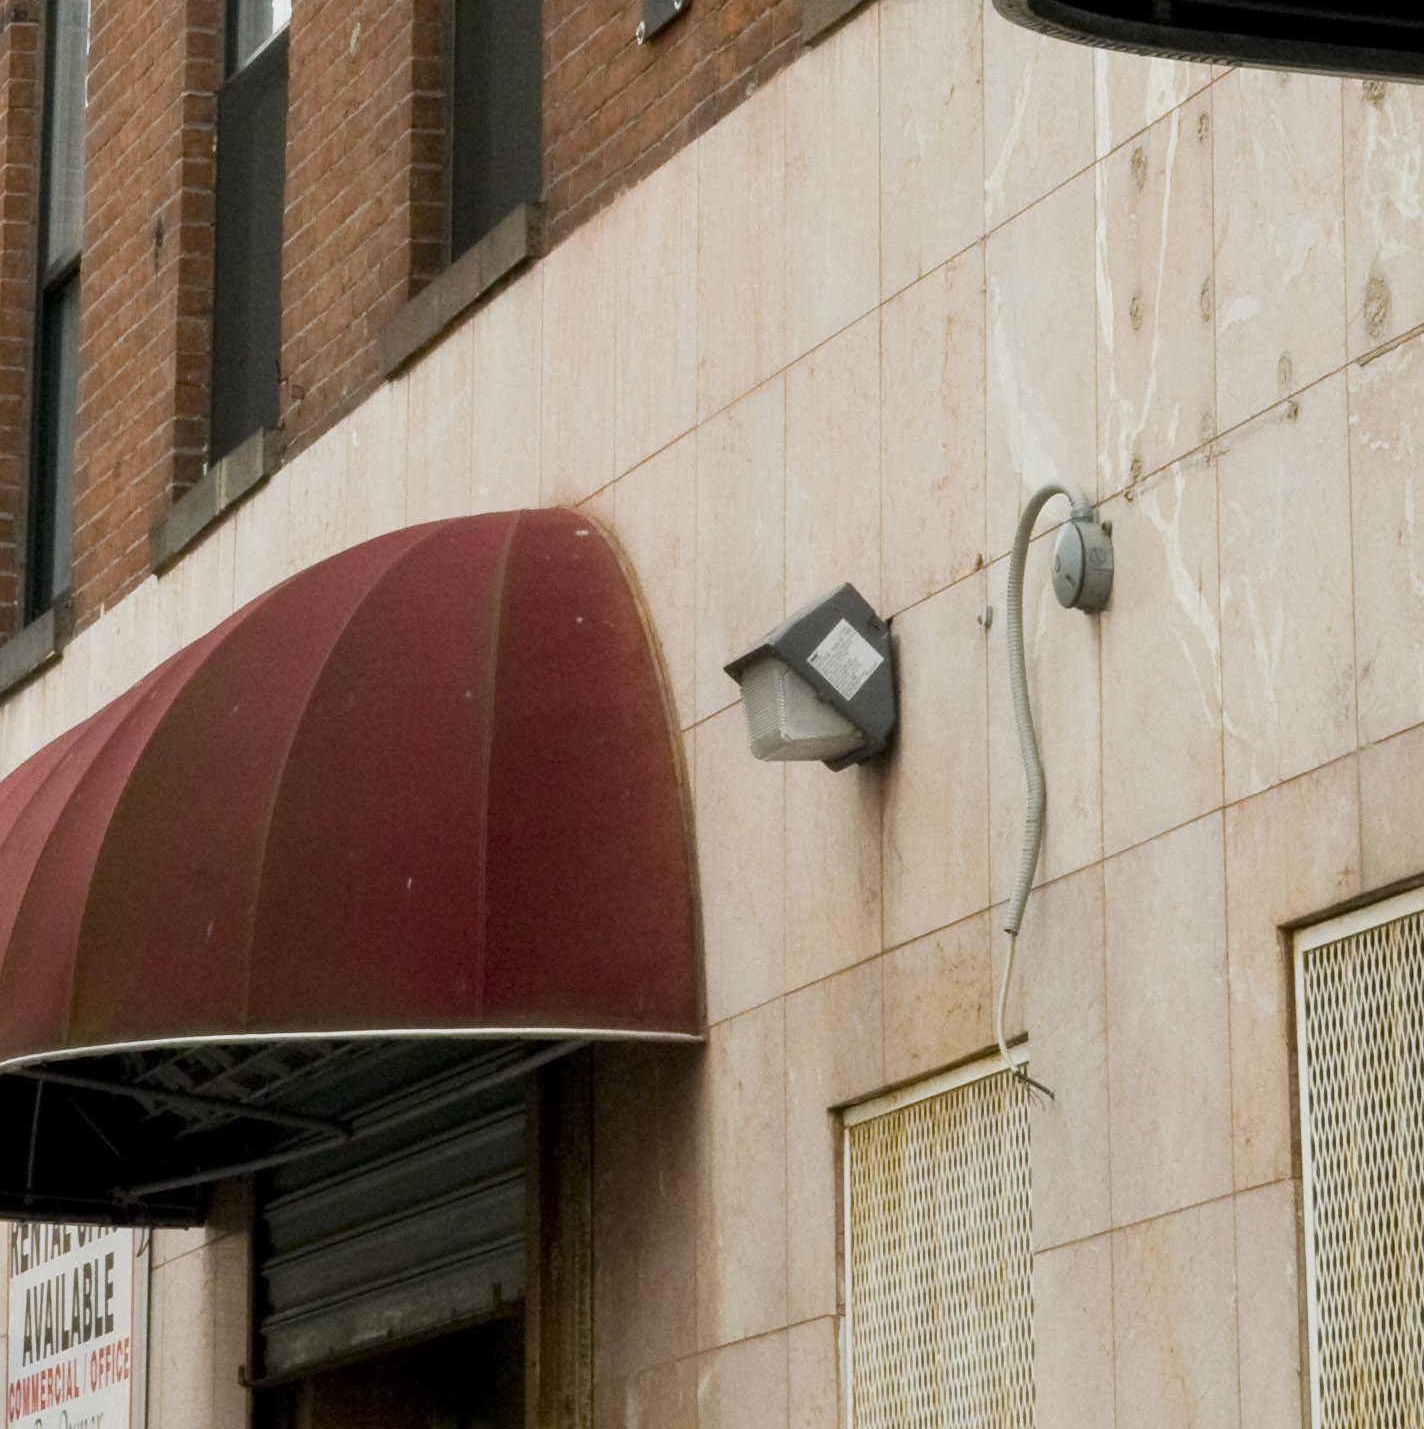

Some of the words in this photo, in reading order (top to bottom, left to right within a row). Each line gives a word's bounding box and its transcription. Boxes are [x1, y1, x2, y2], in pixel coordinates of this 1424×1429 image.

[22, 1252, 114, 1367] AVAILABLE
[8, 1358, 80, 1423] COMMERCIAL
[90, 1338, 130, 1392] OFFICE
